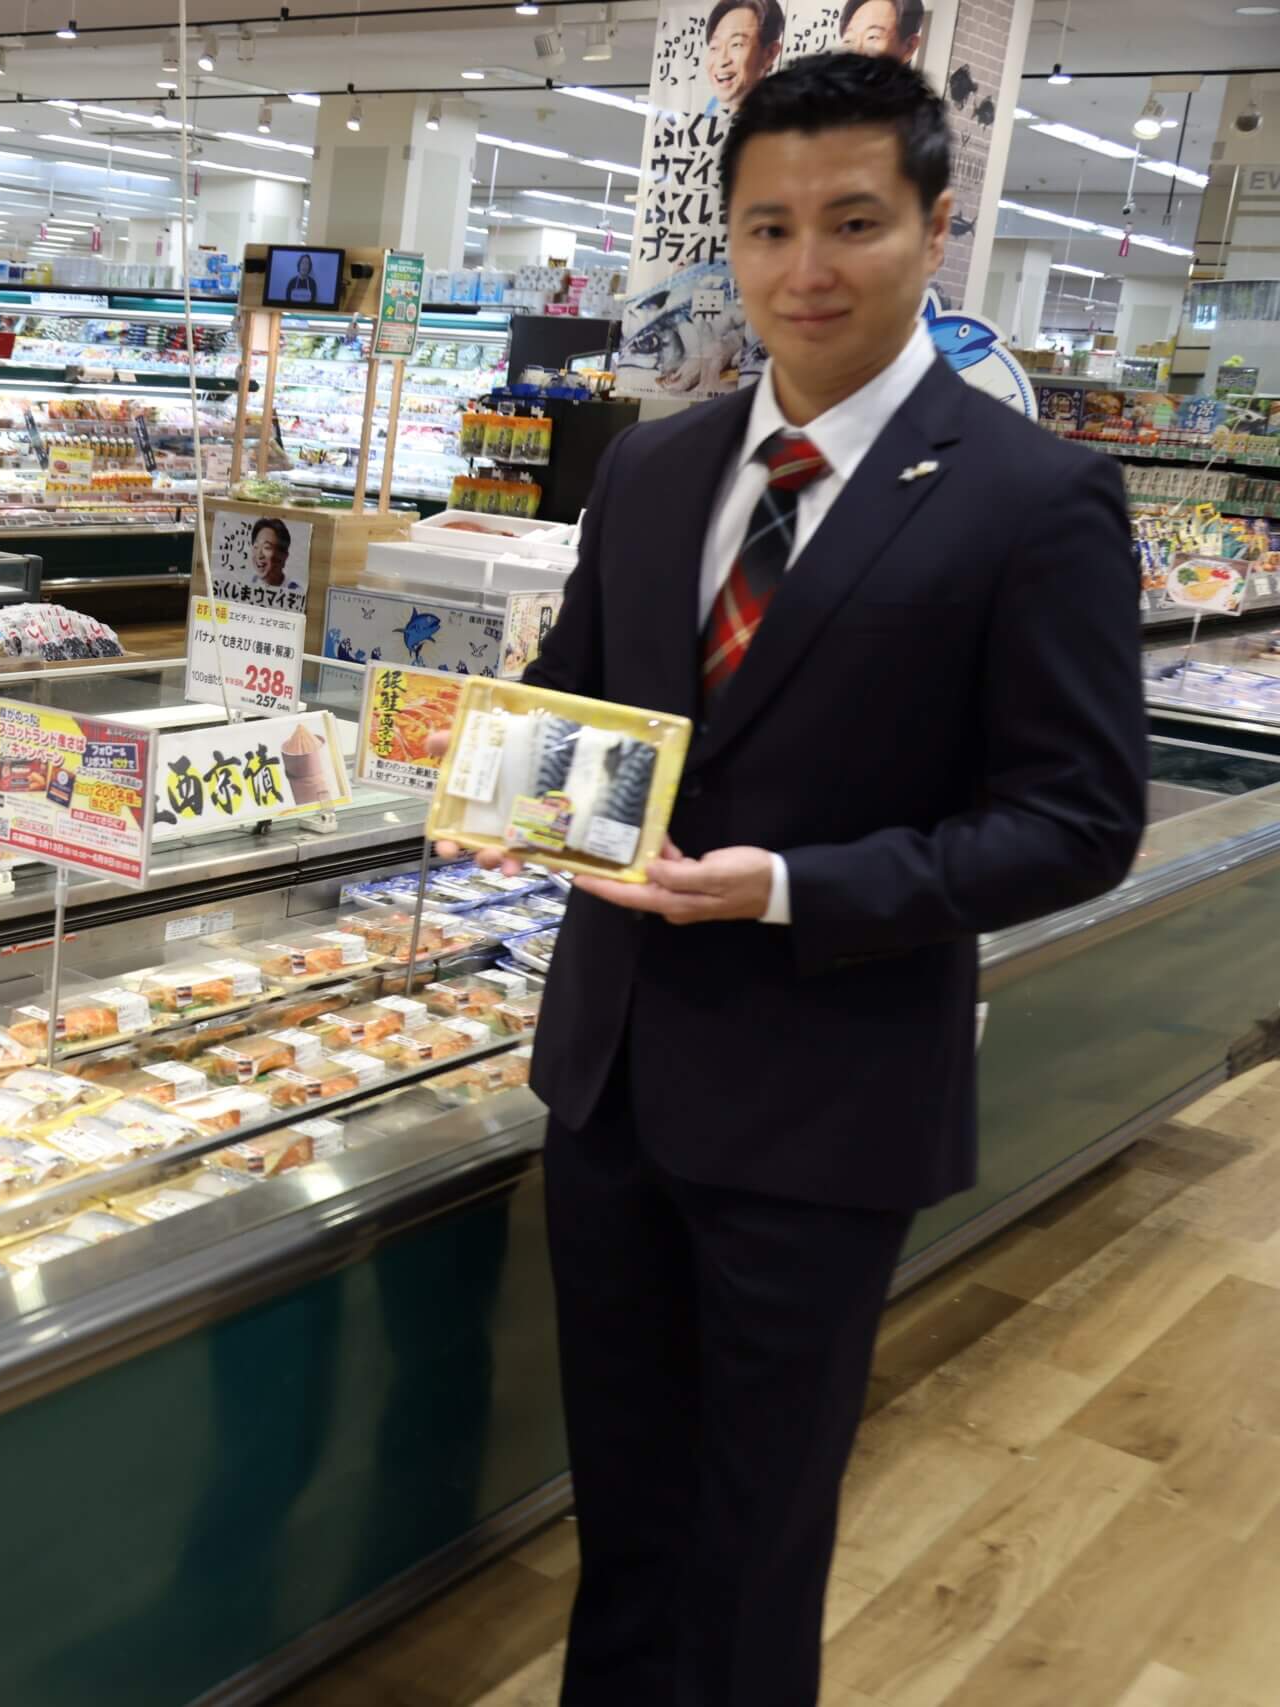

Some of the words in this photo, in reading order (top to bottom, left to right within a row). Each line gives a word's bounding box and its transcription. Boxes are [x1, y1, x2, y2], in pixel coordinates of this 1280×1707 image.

[654, 111, 726, 148] ふくし
[651, 152, 724, 185] ウマイ
[153, 742, 285, 825] 西京漬
